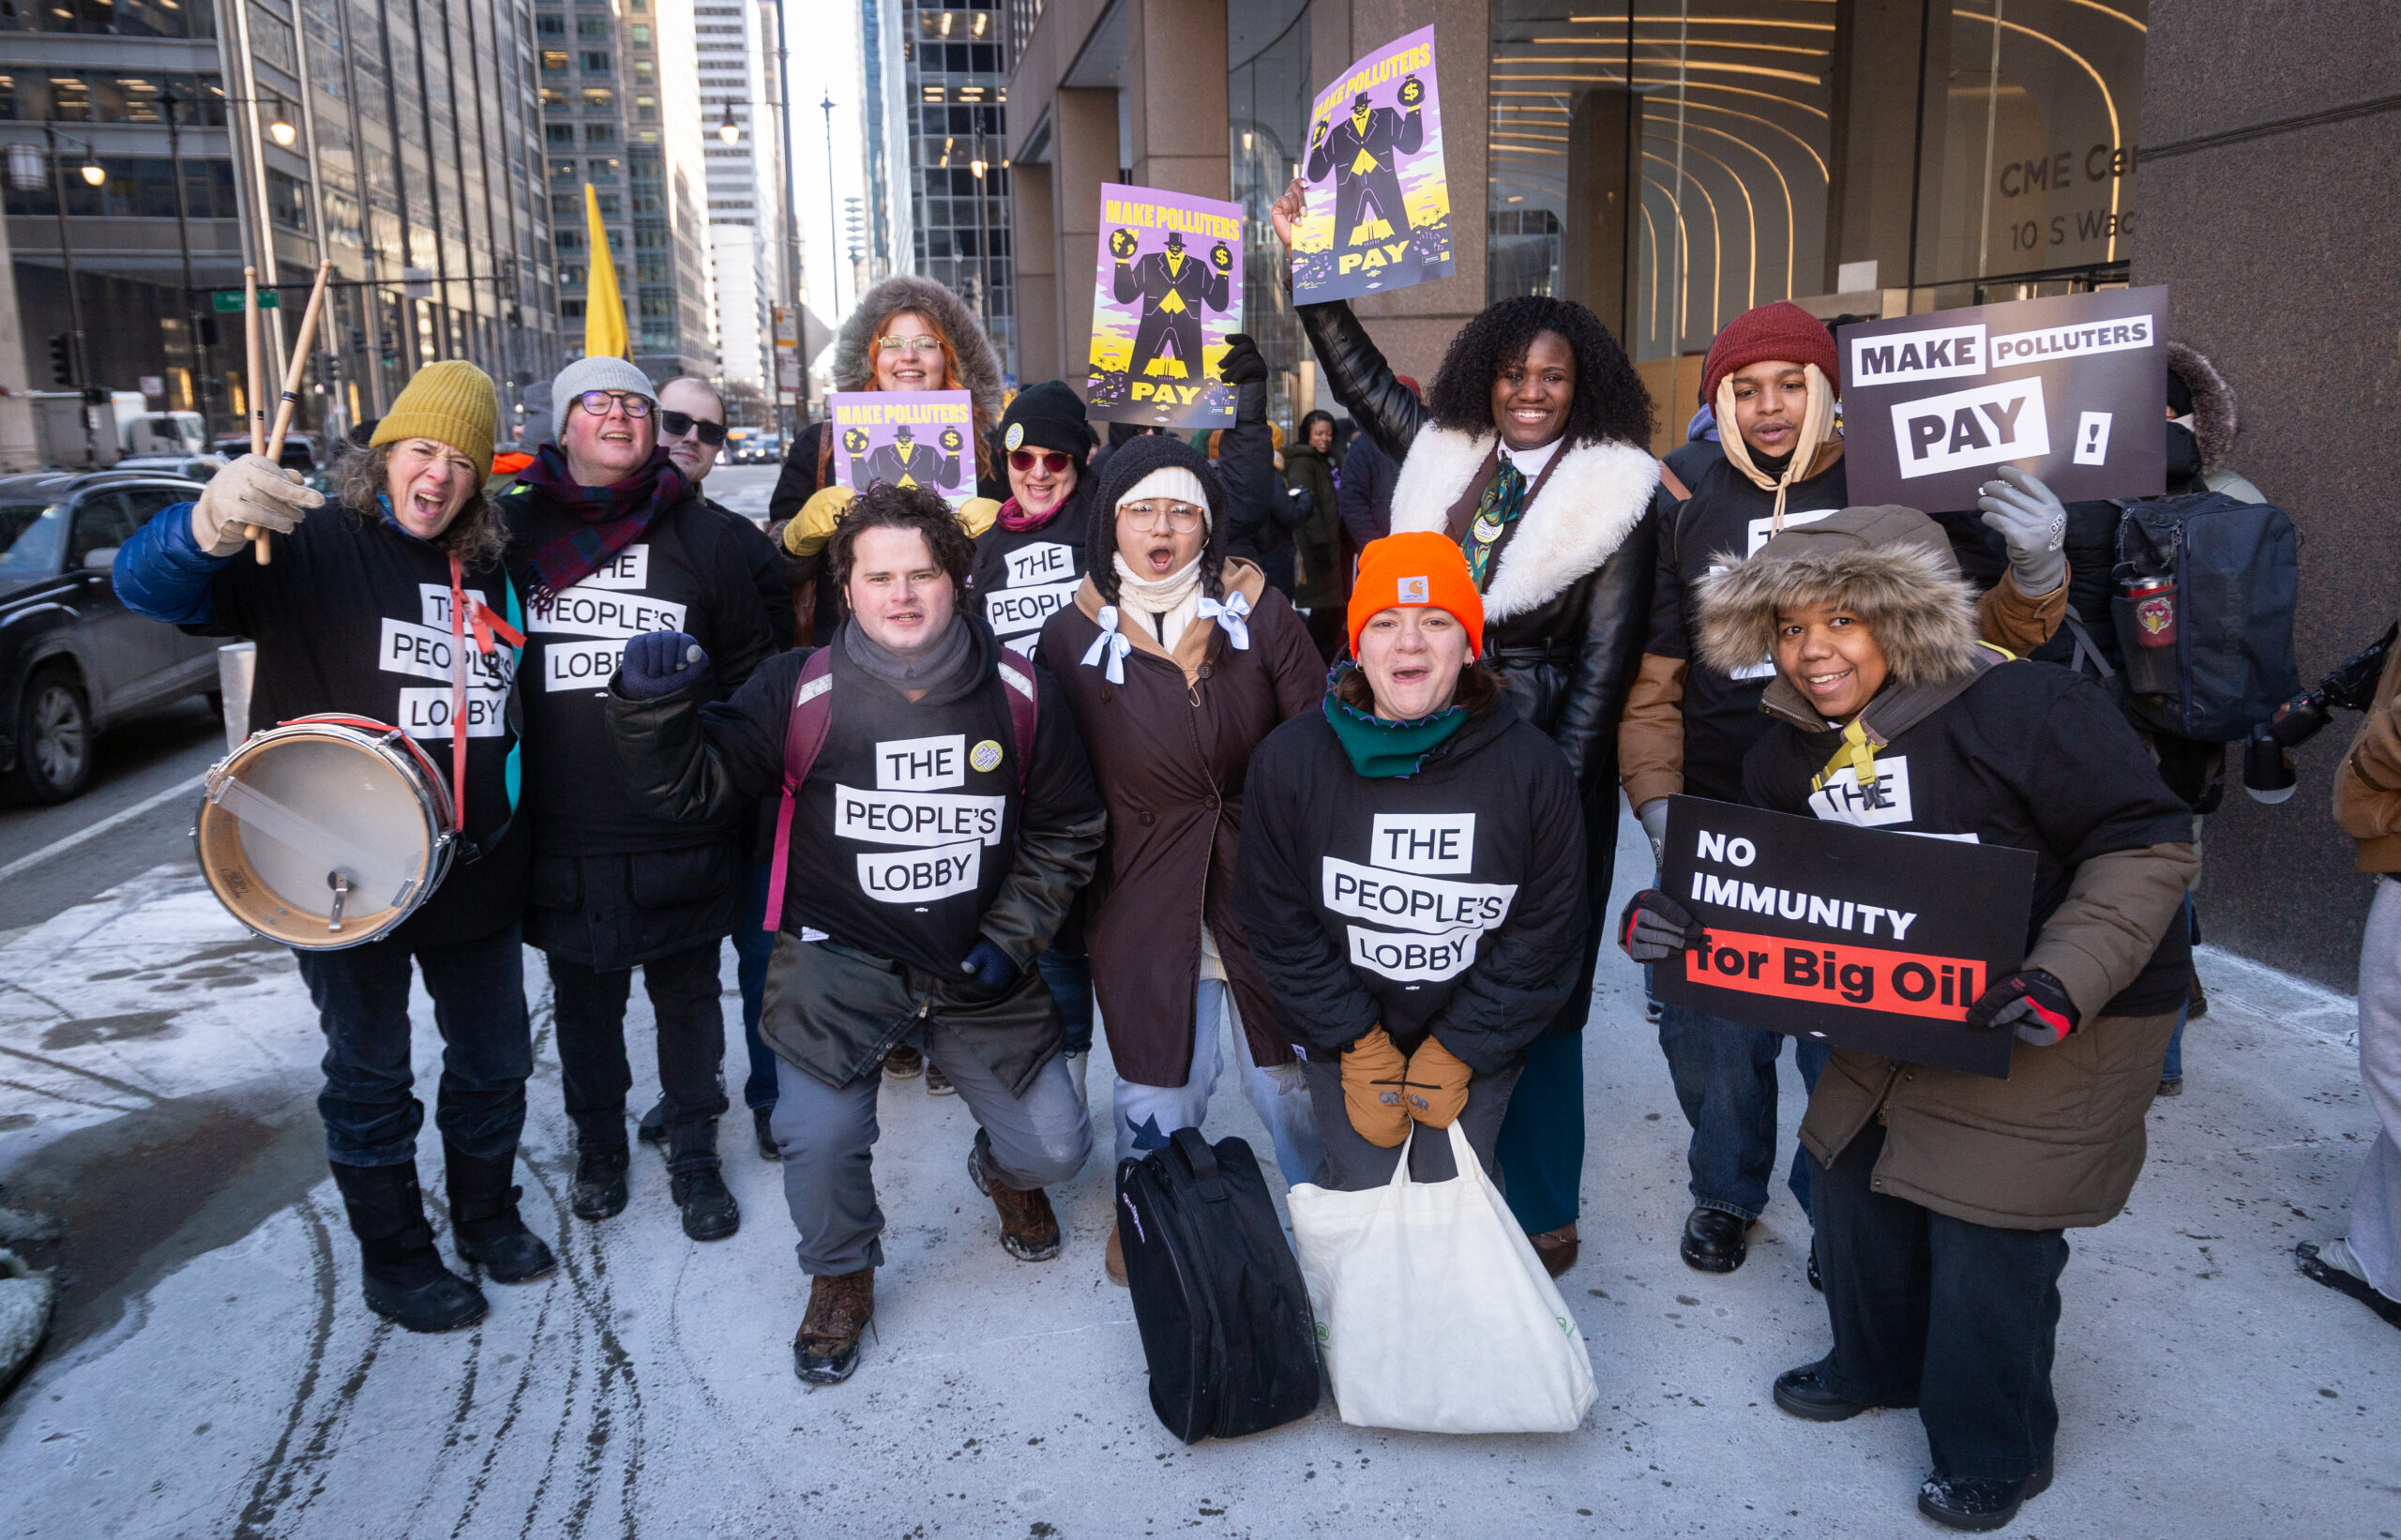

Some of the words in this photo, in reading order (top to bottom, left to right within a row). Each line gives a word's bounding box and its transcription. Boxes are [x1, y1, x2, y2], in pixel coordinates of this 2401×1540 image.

[1313, 83, 1346, 123] MAKE
[1345, 42, 1431, 99] POLLUTERS
[2000, 151, 2072, 198] CME
[1105, 199, 1155, 228] MAKE
[1156, 205, 1240, 241] POLLUTERS
[2011, 220, 2037, 251] 10
[2049, 216, 2065, 245] S
[1338, 240, 1410, 275] PAY
[1860, 336, 1976, 376] MAKE
[1997, 323, 2147, 360] POLLUTERS
[1131, 382, 1201, 405] PAY
[836, 405, 883, 425] MAKE
[884, 403, 969, 424] POLLUTERS
[1908, 396, 2027, 460] PAY
[1014, 547, 1064, 579] THE
[992, 591, 1078, 624] PEOPL
[412, 699, 501, 727] LOBY
[886, 747, 953, 781] THE
[846, 799, 996, 834] PEOPLE'S
[1383, 828, 1460, 860] THE
[1697, 830, 1756, 868] NO
[868, 853, 972, 891] LOBBY
[1335, 872, 1503, 924] PEOPLE'S
[1691, 871, 1918, 941] IMMUNITY
[1360, 934, 1470, 971] LOBBY
[1697, 935, 1769, 980] for
[1784, 946, 1874, 1004] Big
[1891, 961, 1973, 1008] Oil
